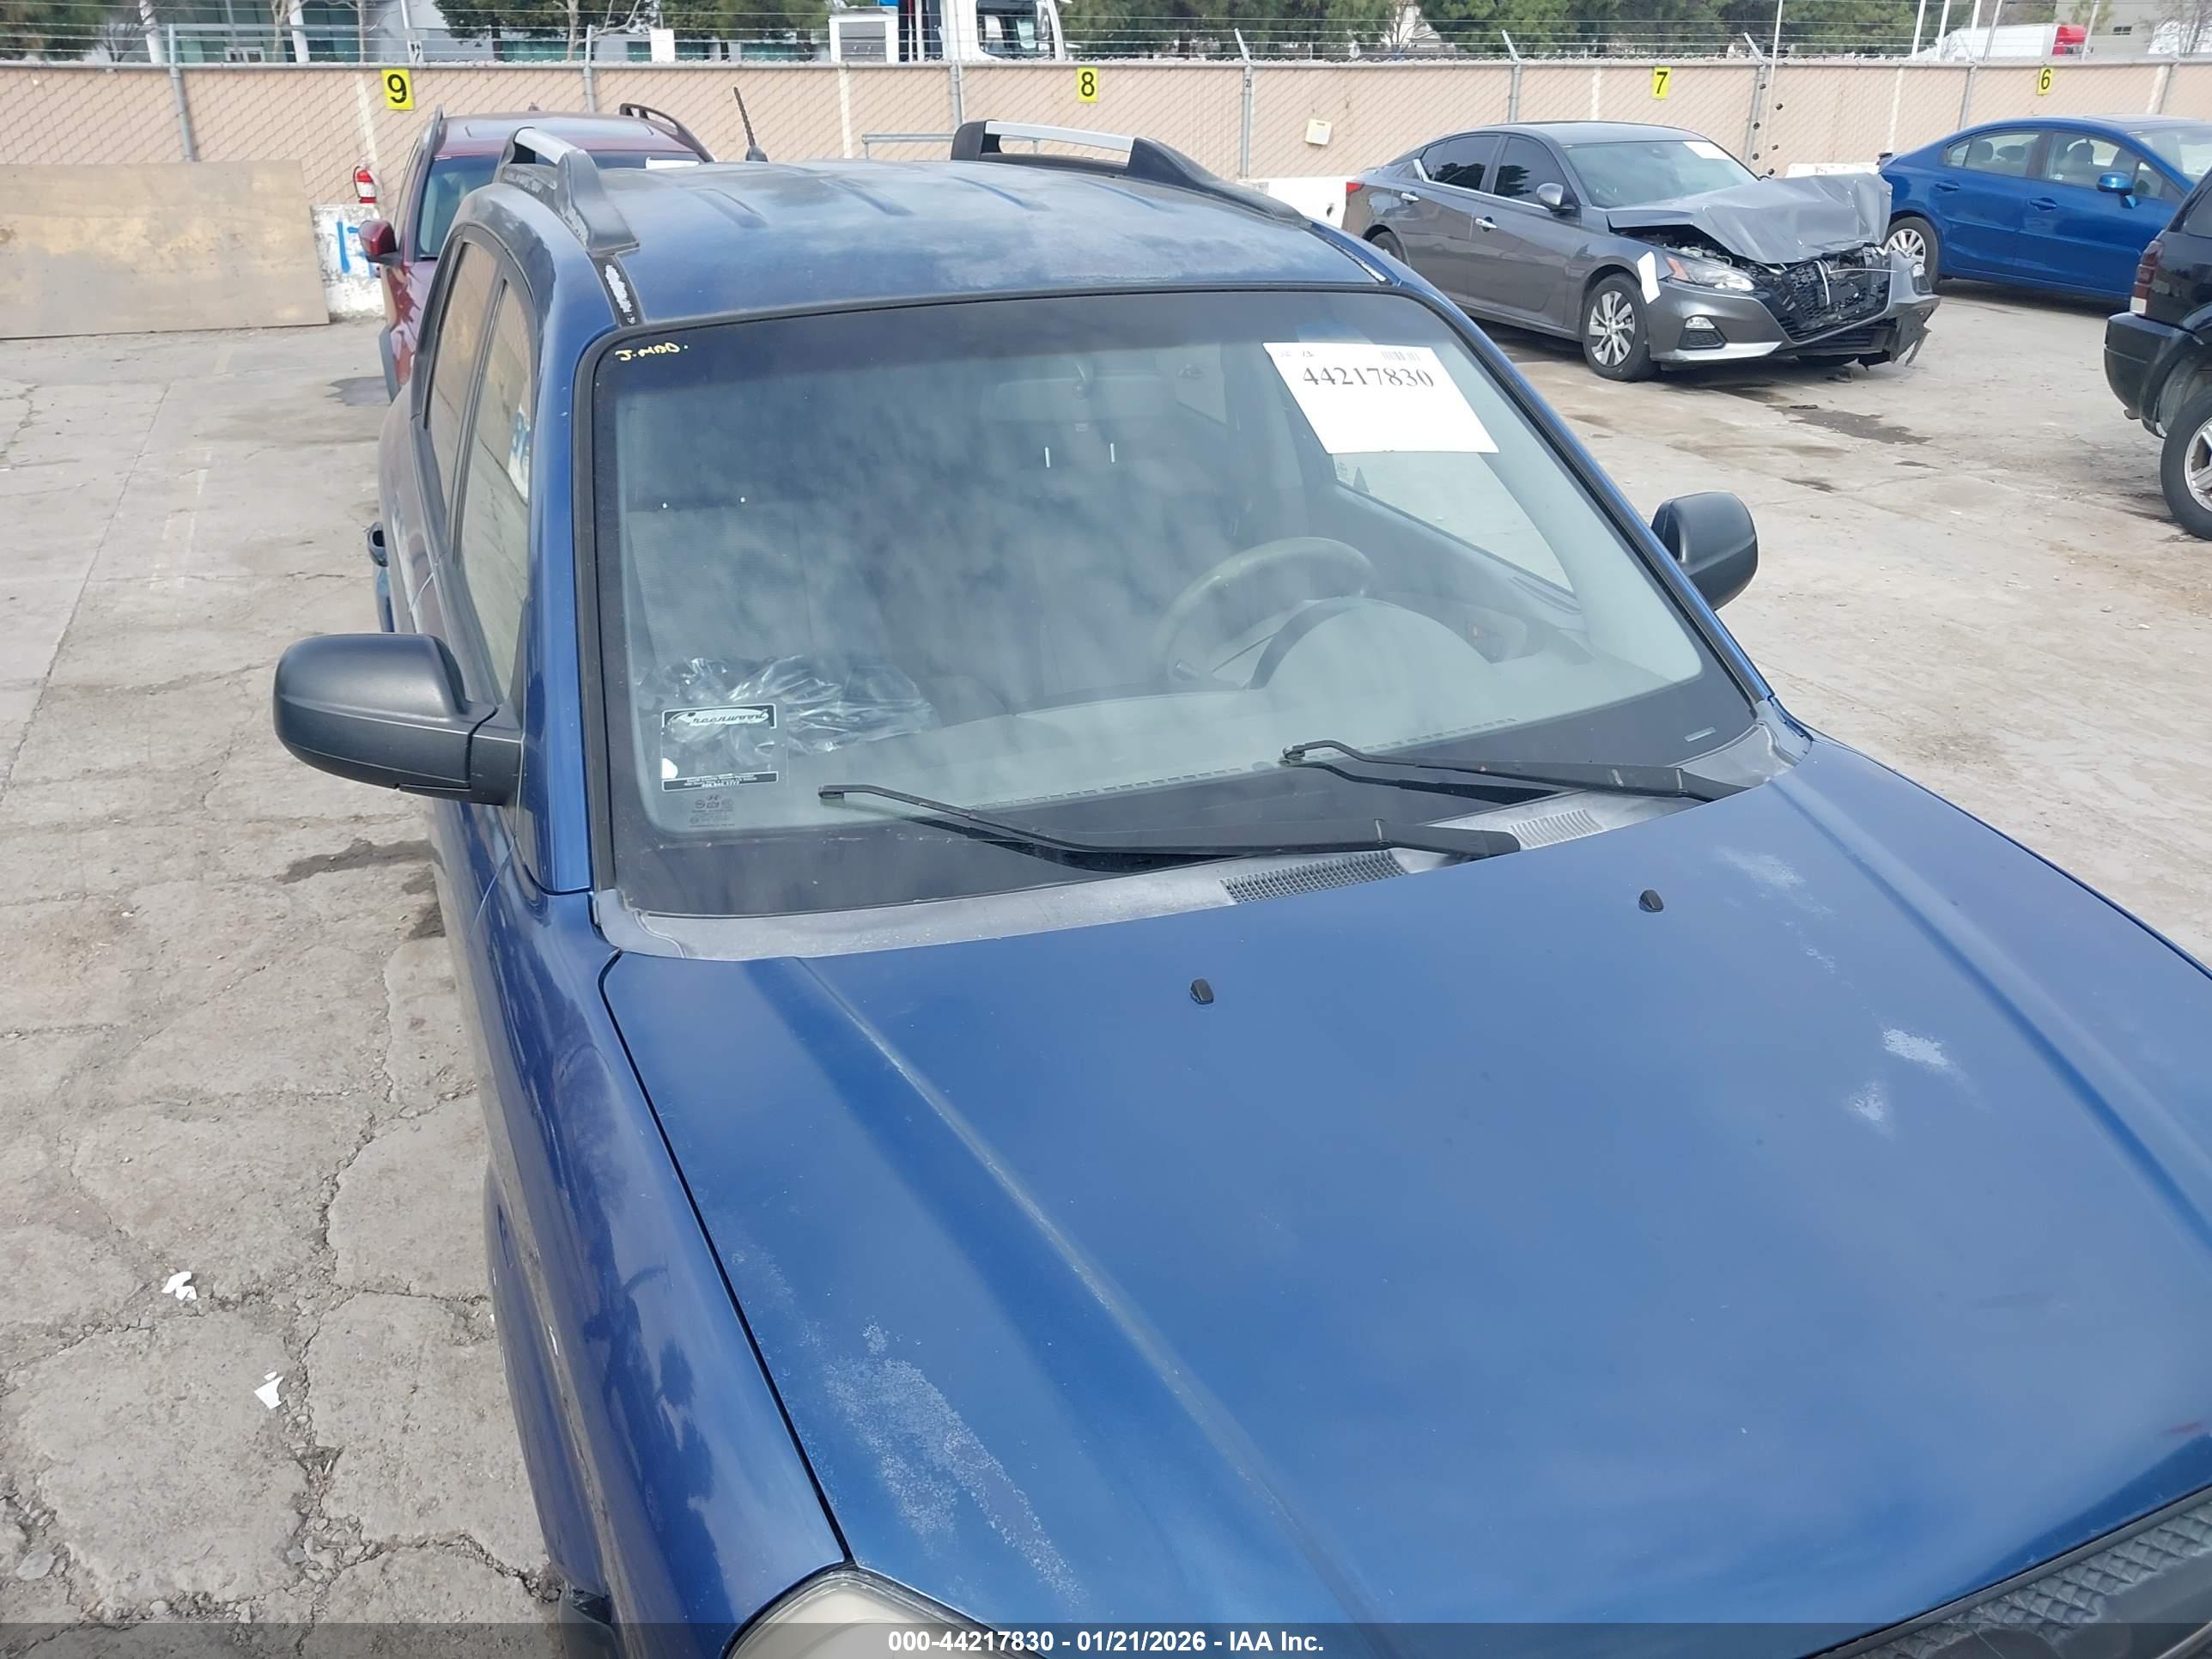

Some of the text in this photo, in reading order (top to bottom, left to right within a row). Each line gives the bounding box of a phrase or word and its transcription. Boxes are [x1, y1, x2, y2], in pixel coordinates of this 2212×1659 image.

[387, 73, 407, 104] 9
[1081, 71, 1095, 97] 8
[1656, 71, 1668, 94] 7
[2041, 68, 2051, 90] 6
[1303, 367, 1434, 387] 44217830
